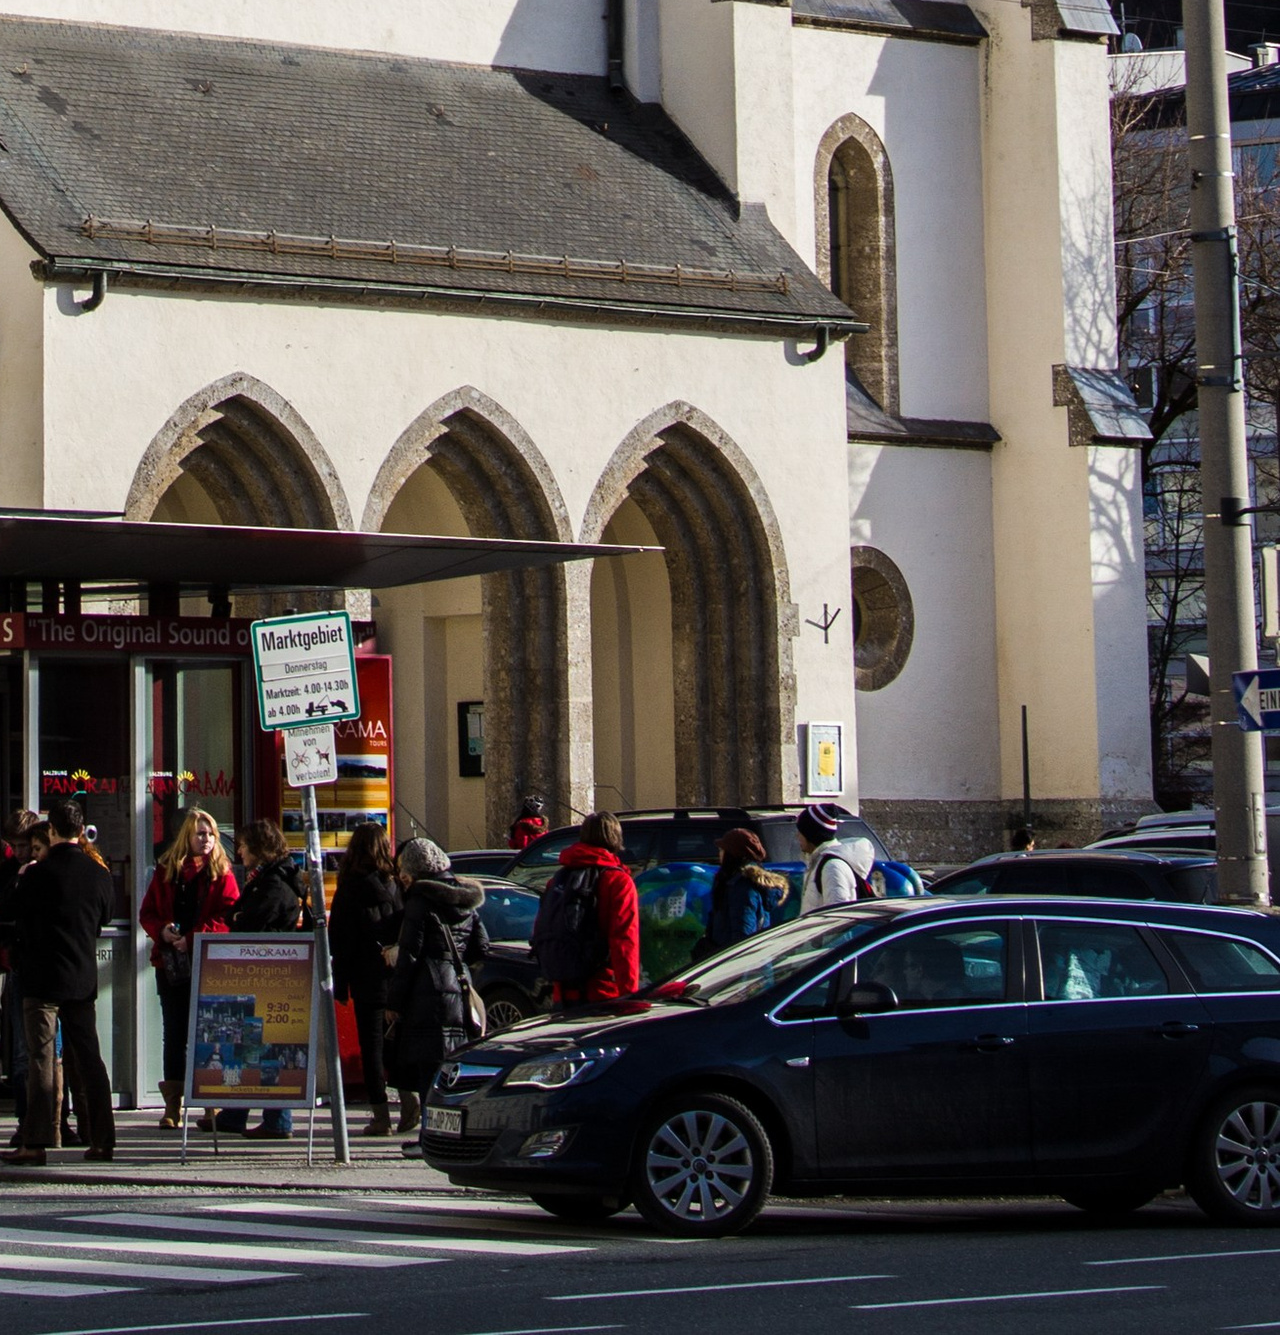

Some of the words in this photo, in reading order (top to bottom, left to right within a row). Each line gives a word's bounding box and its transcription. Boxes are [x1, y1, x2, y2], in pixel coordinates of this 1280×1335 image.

[81, 619, 161, 649] Original
[169, 622, 230, 646] Sound
[261, 625, 344, 652] Marktgebiet
[285, 661, 328, 674] Donnerstag
[265, 686, 301, 700] Marktzeit:
[267, 708, 276, 718] ab
[279, 704, 301, 717] 4.00h
[288, 725, 331, 738] Mitnehmen
[302, 738, 317, 747] von
[295, 768, 331, 782] verboten!
[240, 947, 298, 957] PANORAMA
[223, 964, 242, 975] The
[247, 964, 291, 977] Original
[266, 1002, 290, 1013] 9:30
[265, 1013, 289, 1024] 2:00
